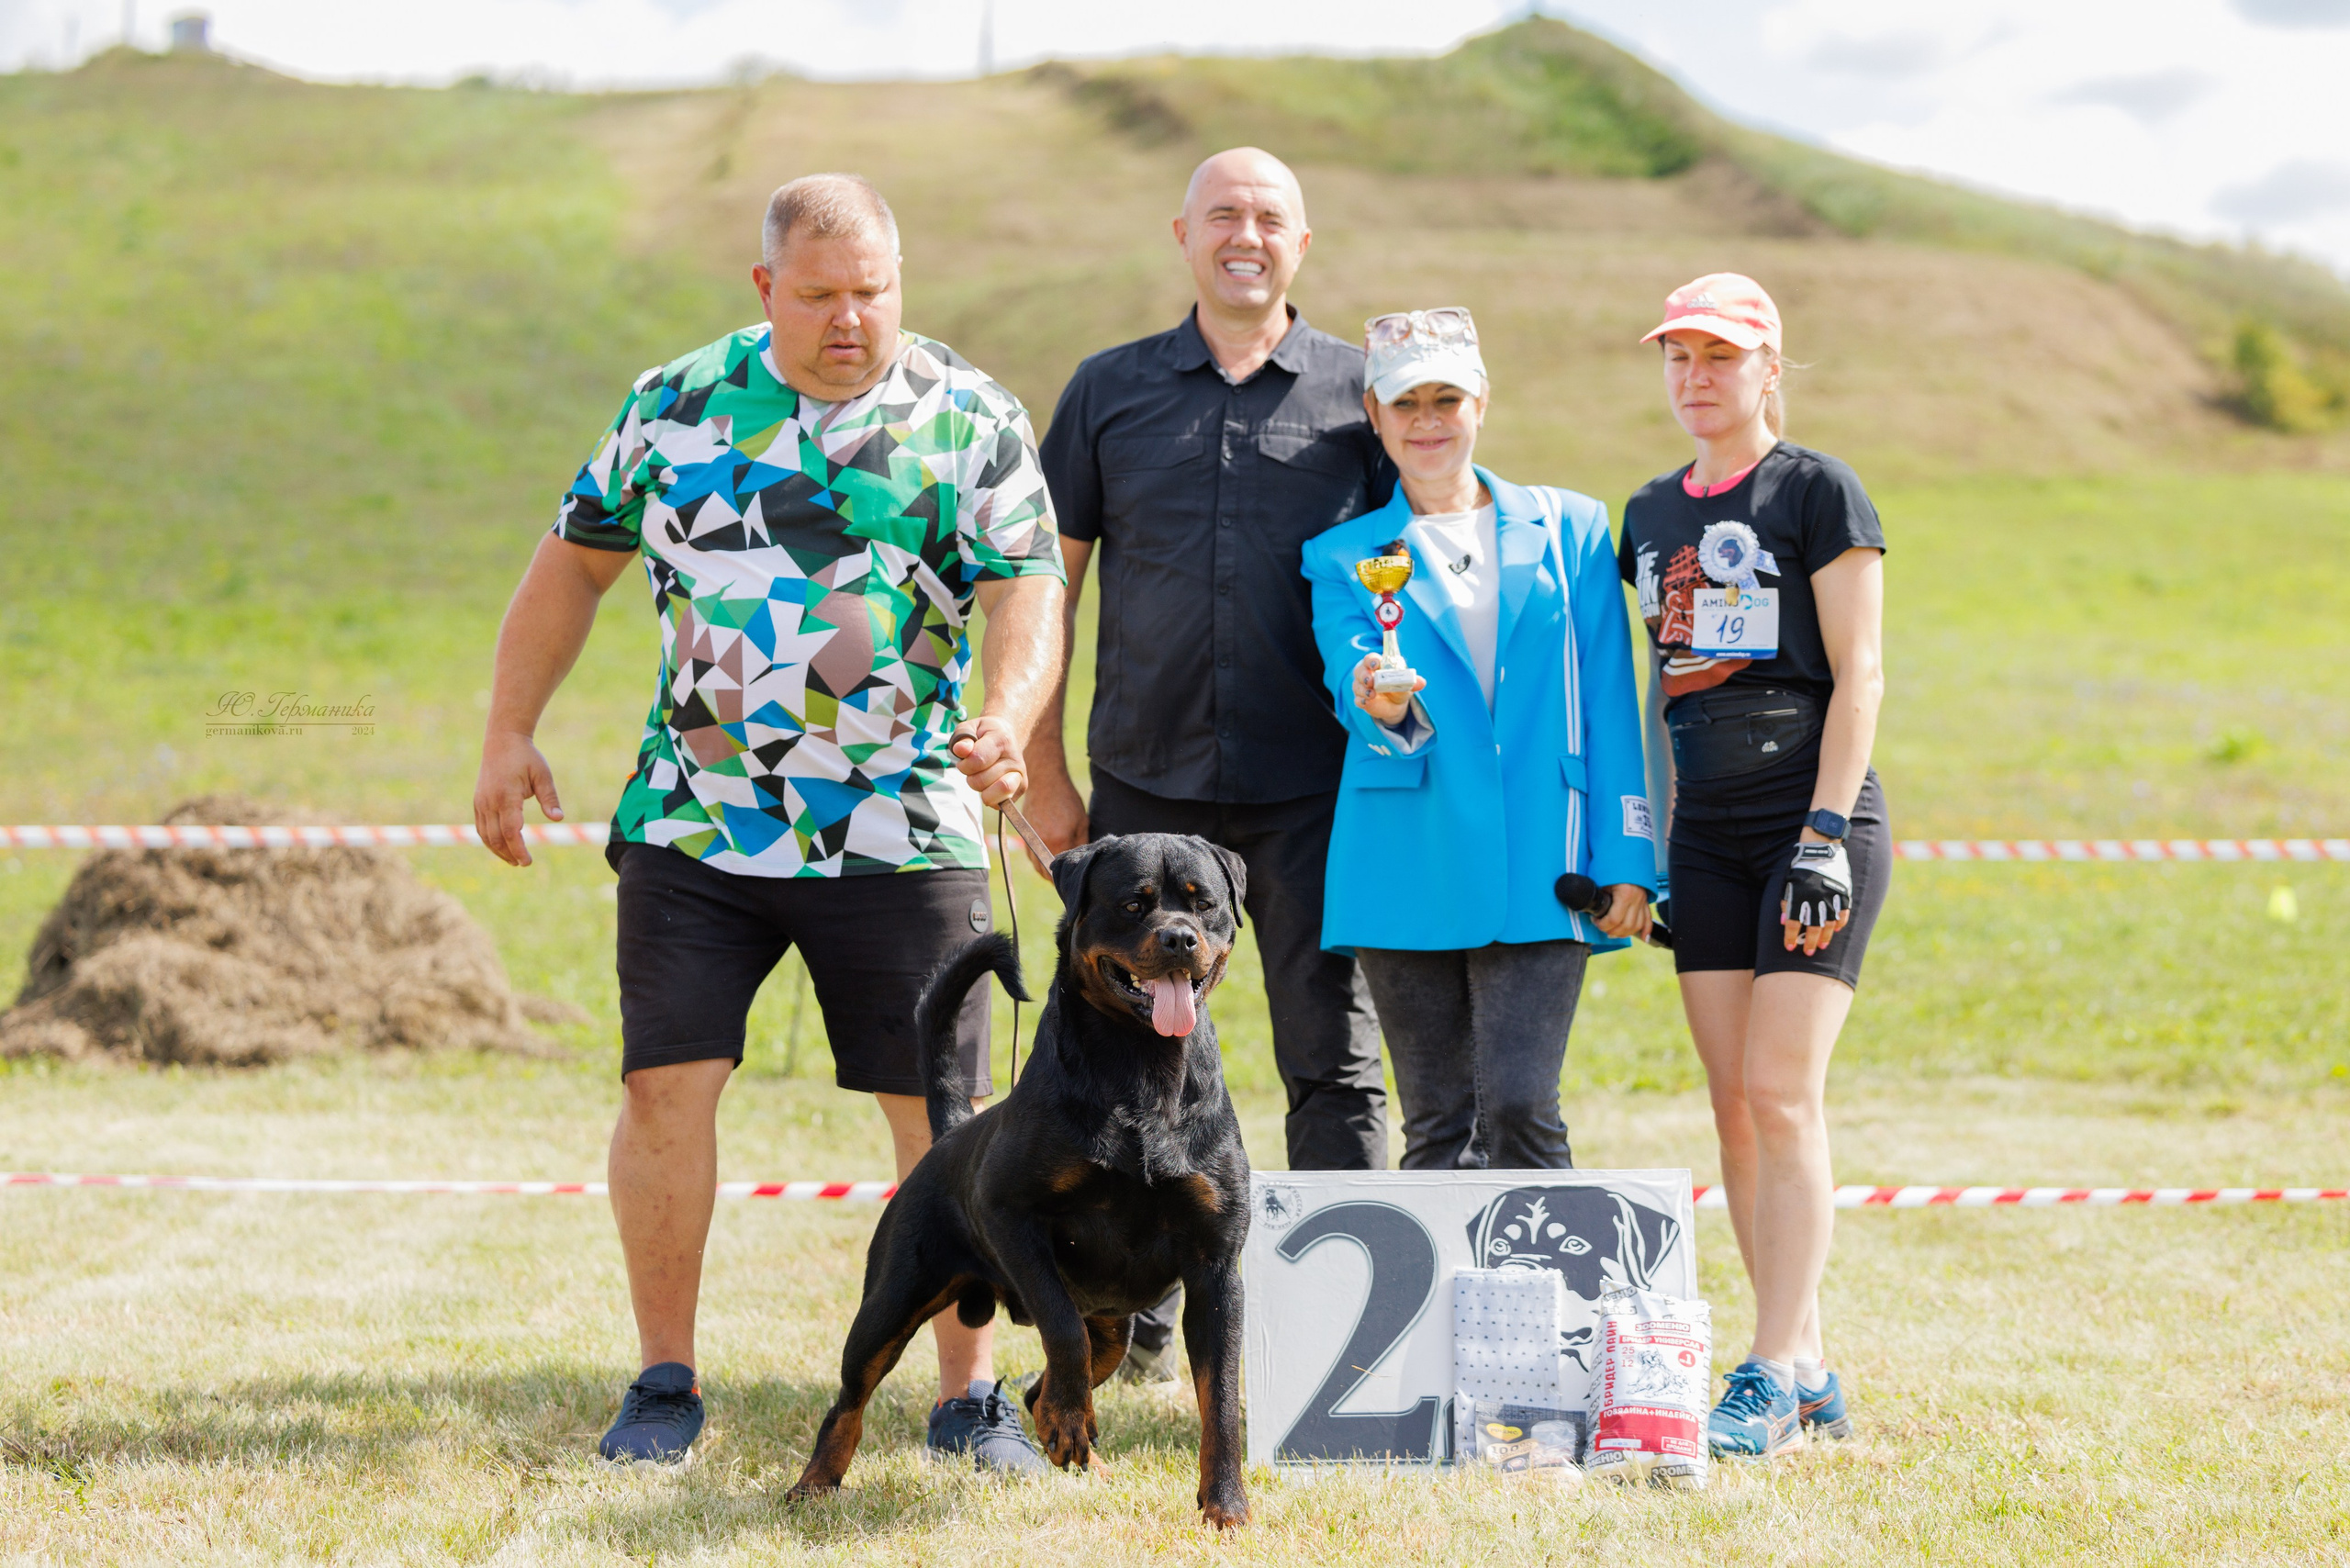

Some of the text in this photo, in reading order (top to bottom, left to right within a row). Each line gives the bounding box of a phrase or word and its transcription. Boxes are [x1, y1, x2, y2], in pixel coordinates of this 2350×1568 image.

[1716, 614, 1745, 644] 19
[1275, 1200, 1440, 1465] 2
[1636, 1322, 1690, 1331] ЗООМЕНЮ
[1622, 1346, 1635, 1355] 25
[1621, 1359, 1634, 1368] 12
[1604, 1358, 1616, 1407] БРИДЕР
